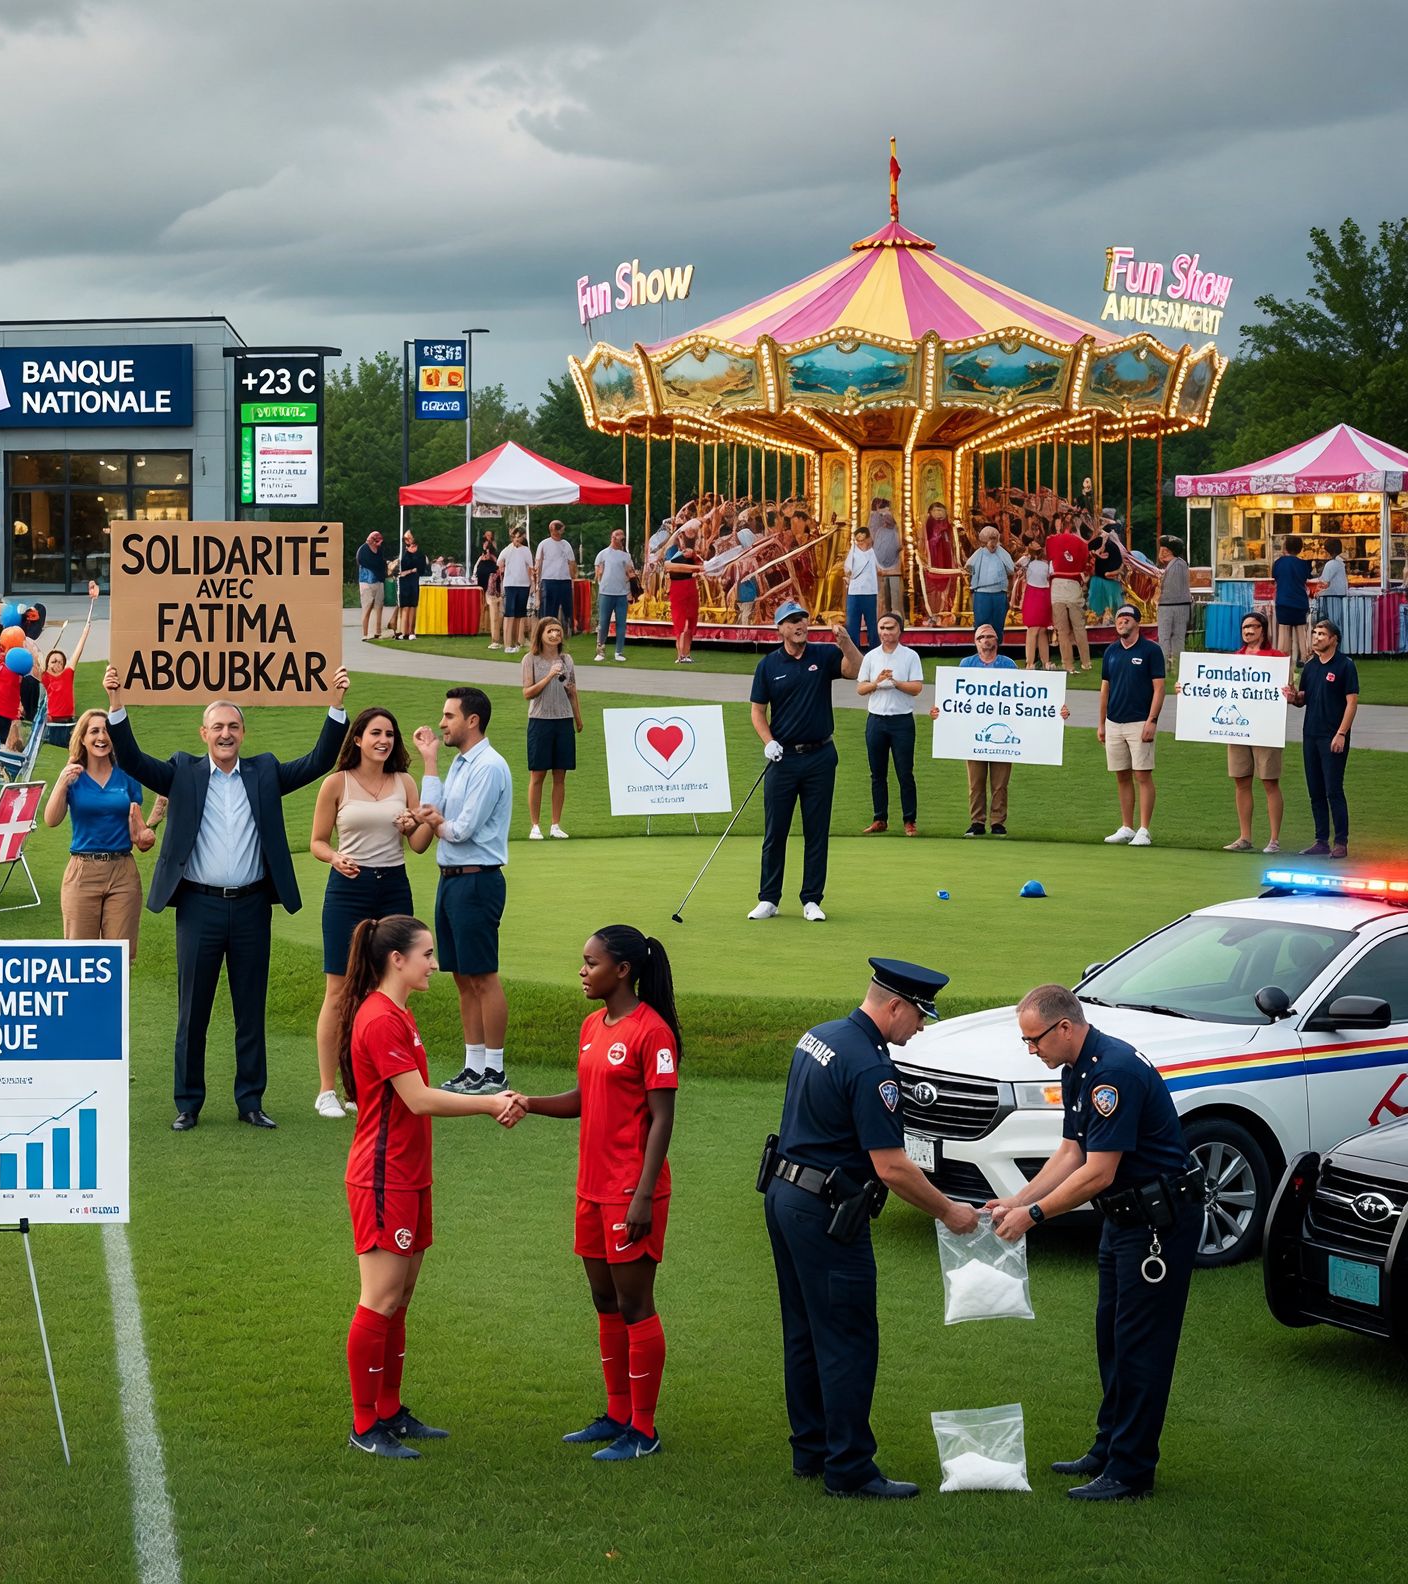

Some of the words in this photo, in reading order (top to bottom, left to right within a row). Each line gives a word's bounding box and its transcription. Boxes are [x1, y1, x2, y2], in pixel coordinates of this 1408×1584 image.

[1105, 246, 1164, 296] Fun
[577, 275, 611, 324] Fun
[615, 258, 694, 310] Show
[22, 359, 135, 386] BANQUE
[241, 368, 292, 395] +23
[297, 368, 316, 394] C
[22, 390, 171, 414] NATIONALE
[121, 525, 330, 576] SOLIDARITÉ
[196, 578, 254, 600] AVEC
[158, 602, 297, 644] FATIMA
[124, 650, 329, 692] ABOUBKAR
[1196, 665, 1272, 683] Fondation
[955, 679, 1048, 699] Fondation
[942, 699, 972, 714] Cité
[976, 701, 994, 715] de
[998, 702, 1011, 715] la
[1015, 703, 1056, 718] Santé
